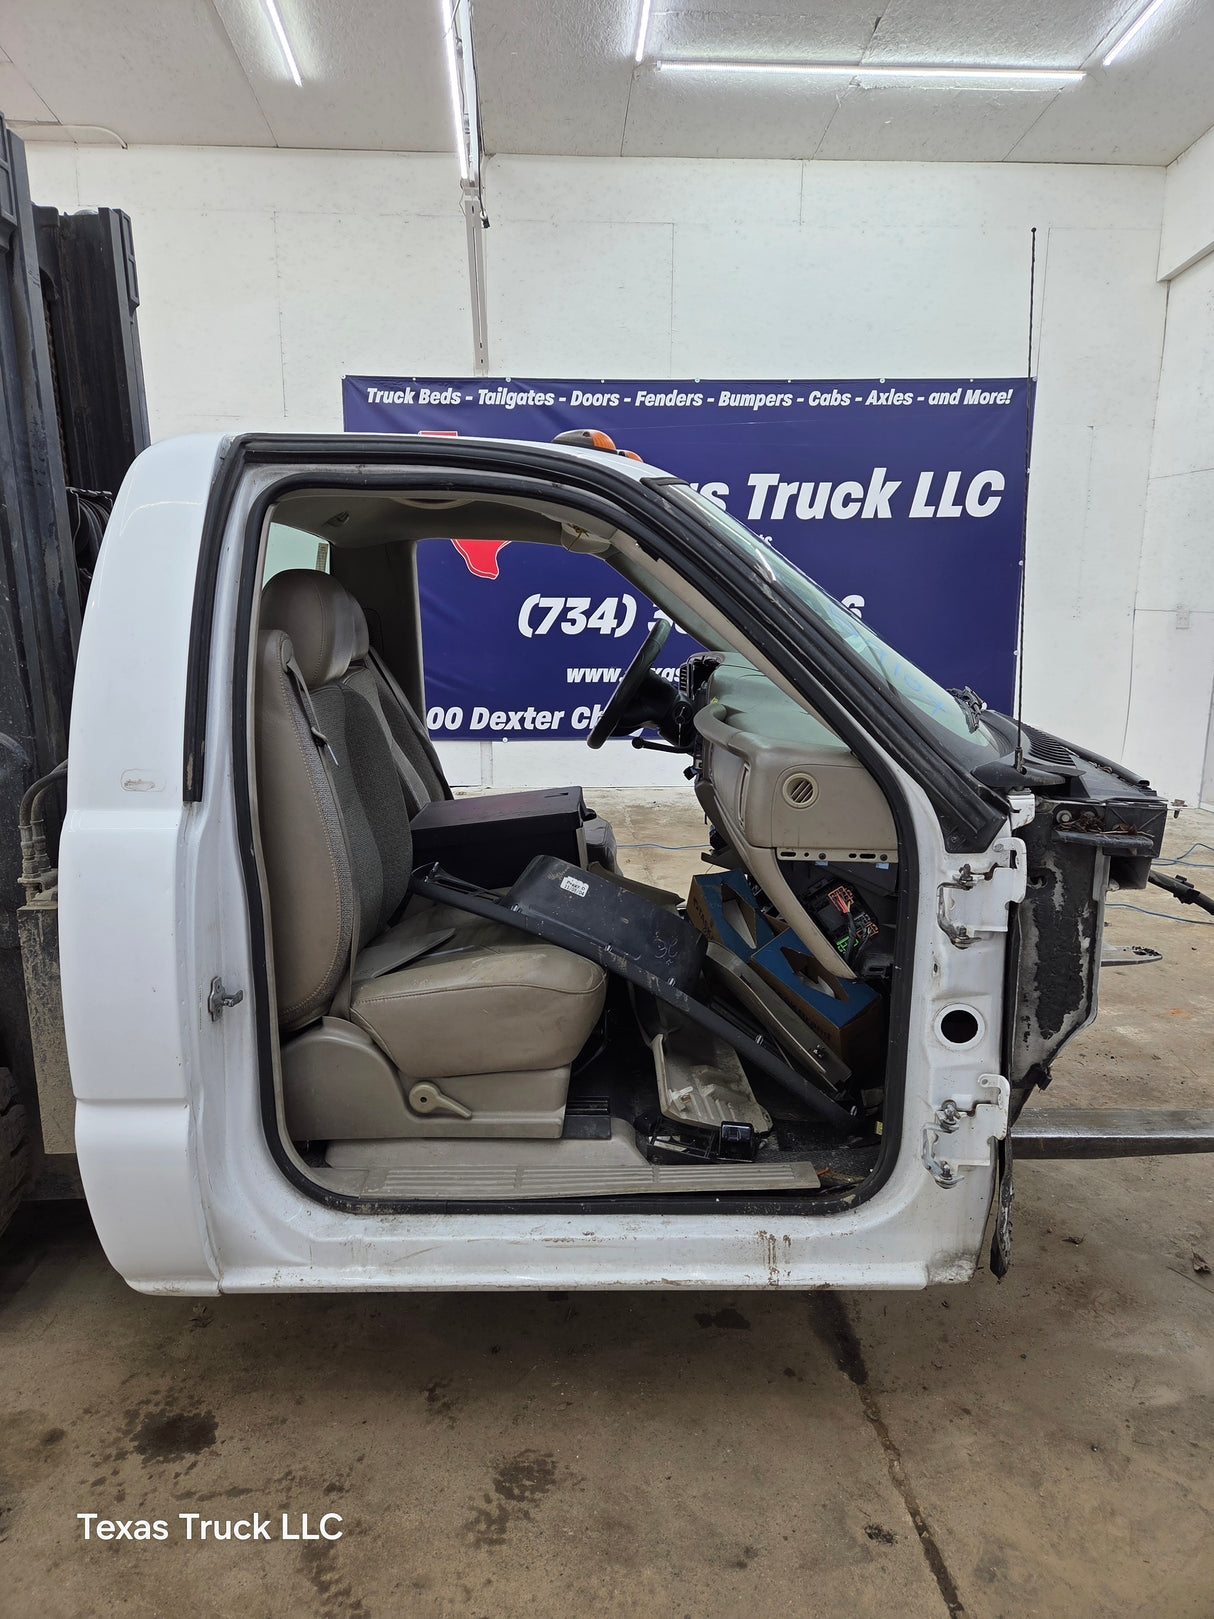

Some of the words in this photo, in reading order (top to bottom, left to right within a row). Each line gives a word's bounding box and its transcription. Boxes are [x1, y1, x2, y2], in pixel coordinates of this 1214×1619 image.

[366, 387, 416, 405] Truck
[418, 388, 462, 405] Beds
[477, 387, 556, 410] Tailgates
[569, 391, 620, 407] Doors
[634, 390, 704, 407] Fenders
[717, 391, 793, 411] Bumpers
[808, 389, 852, 406] Cabs
[865, 389, 914, 405] Axles
[928, 388, 962, 405] and
[963, 388, 1014, 405] More!
[747, 467, 903, 520] Truck
[908, 469, 1006, 518] LLC
[517, 593, 638, 638] (734)
[469, 706, 566, 731] Dexter
